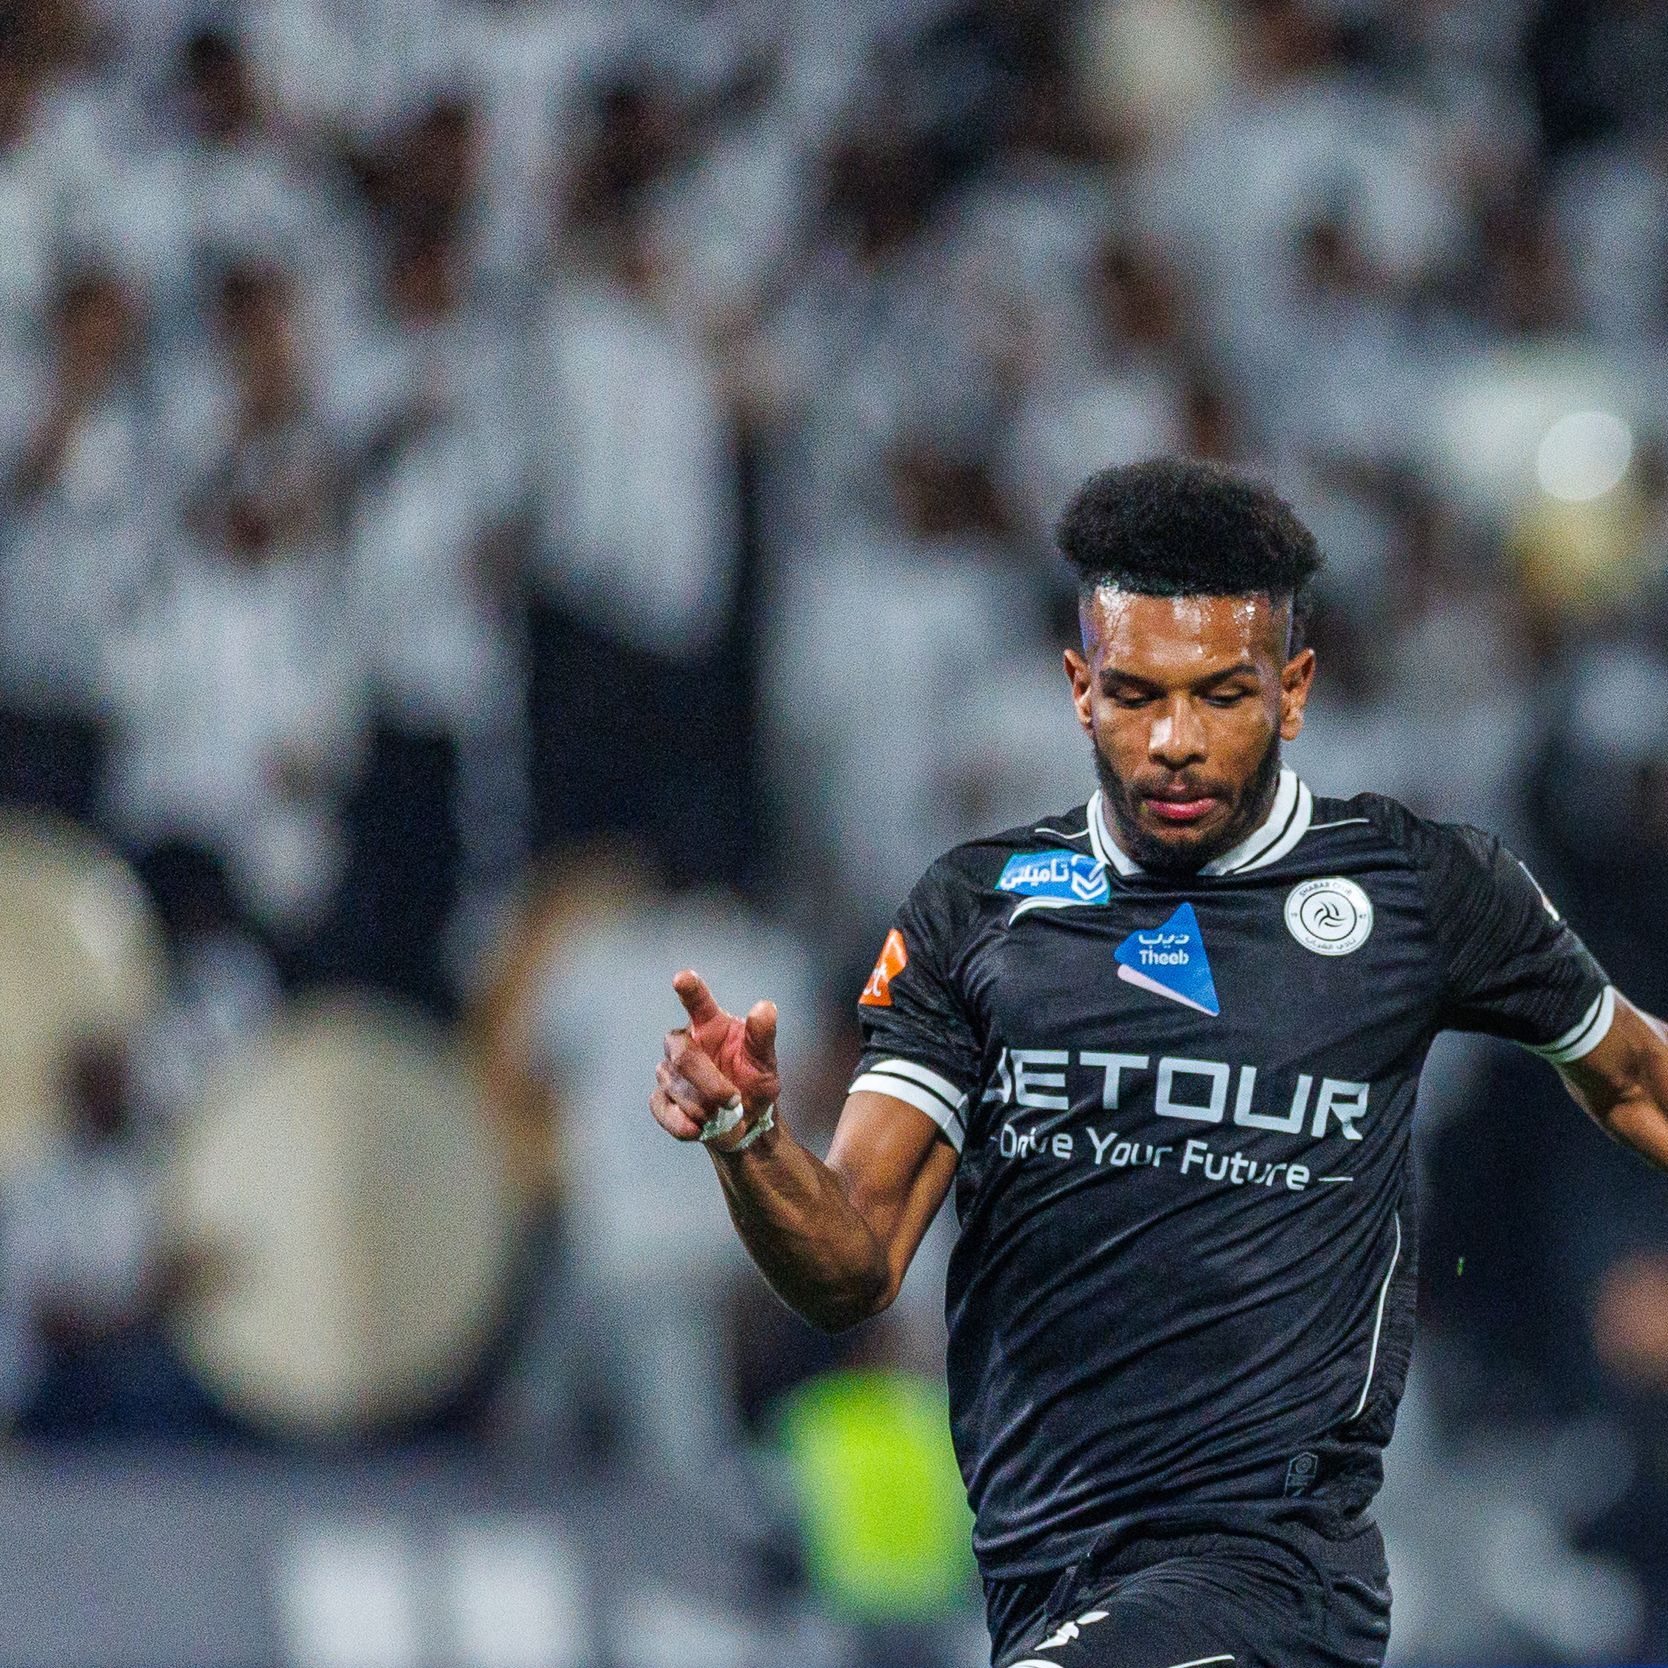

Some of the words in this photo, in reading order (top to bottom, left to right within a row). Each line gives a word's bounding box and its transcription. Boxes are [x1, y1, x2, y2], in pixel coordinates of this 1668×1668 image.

[1138, 948, 1190, 965] Theeb
[981, 1046, 1371, 1141] JETOUR
[999, 1123, 1074, 1160] Drive
[1085, 1126, 1173, 1169] Your
[1180, 1139, 1311, 1192] Future
